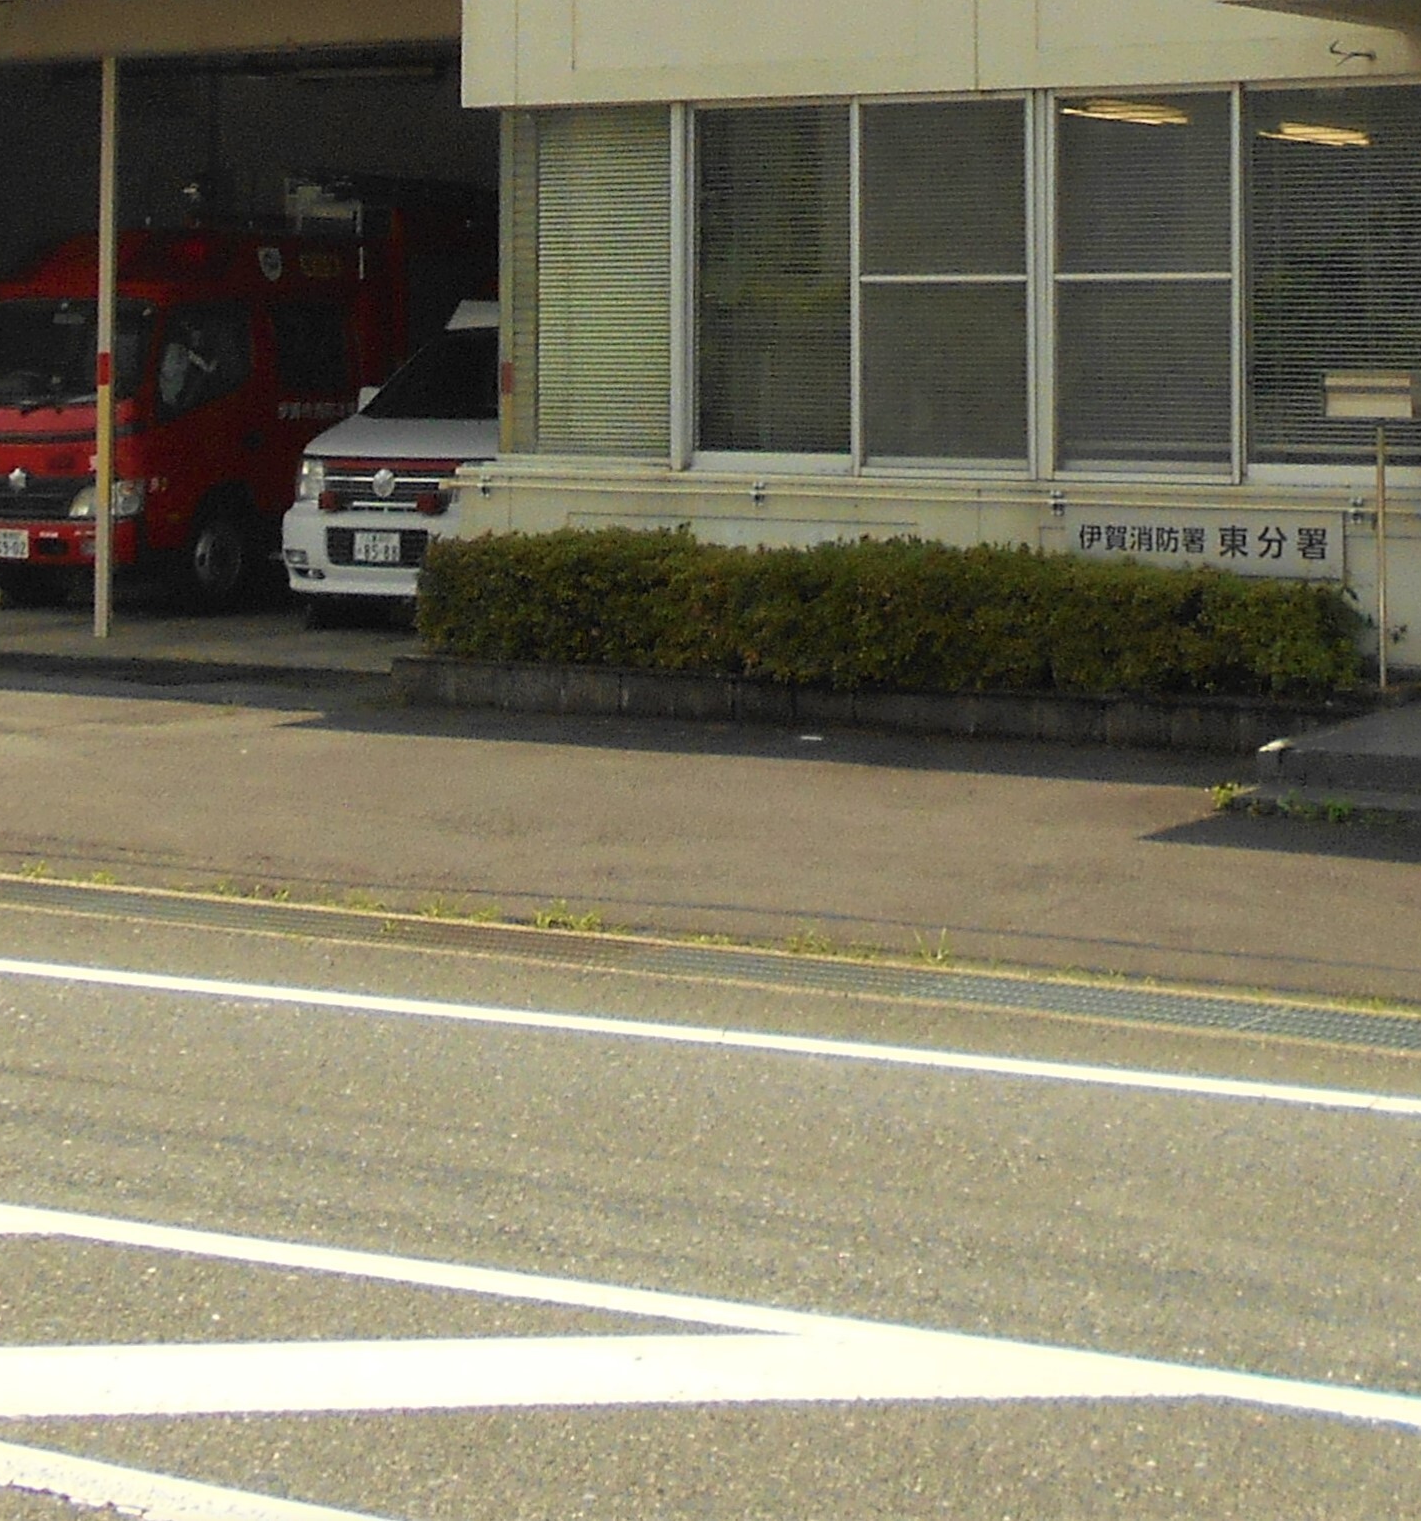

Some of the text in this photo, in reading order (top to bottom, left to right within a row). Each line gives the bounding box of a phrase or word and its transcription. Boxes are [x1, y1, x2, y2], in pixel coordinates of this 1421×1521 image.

[1079, 524, 1328, 560] 伊賀消防署 東分署
